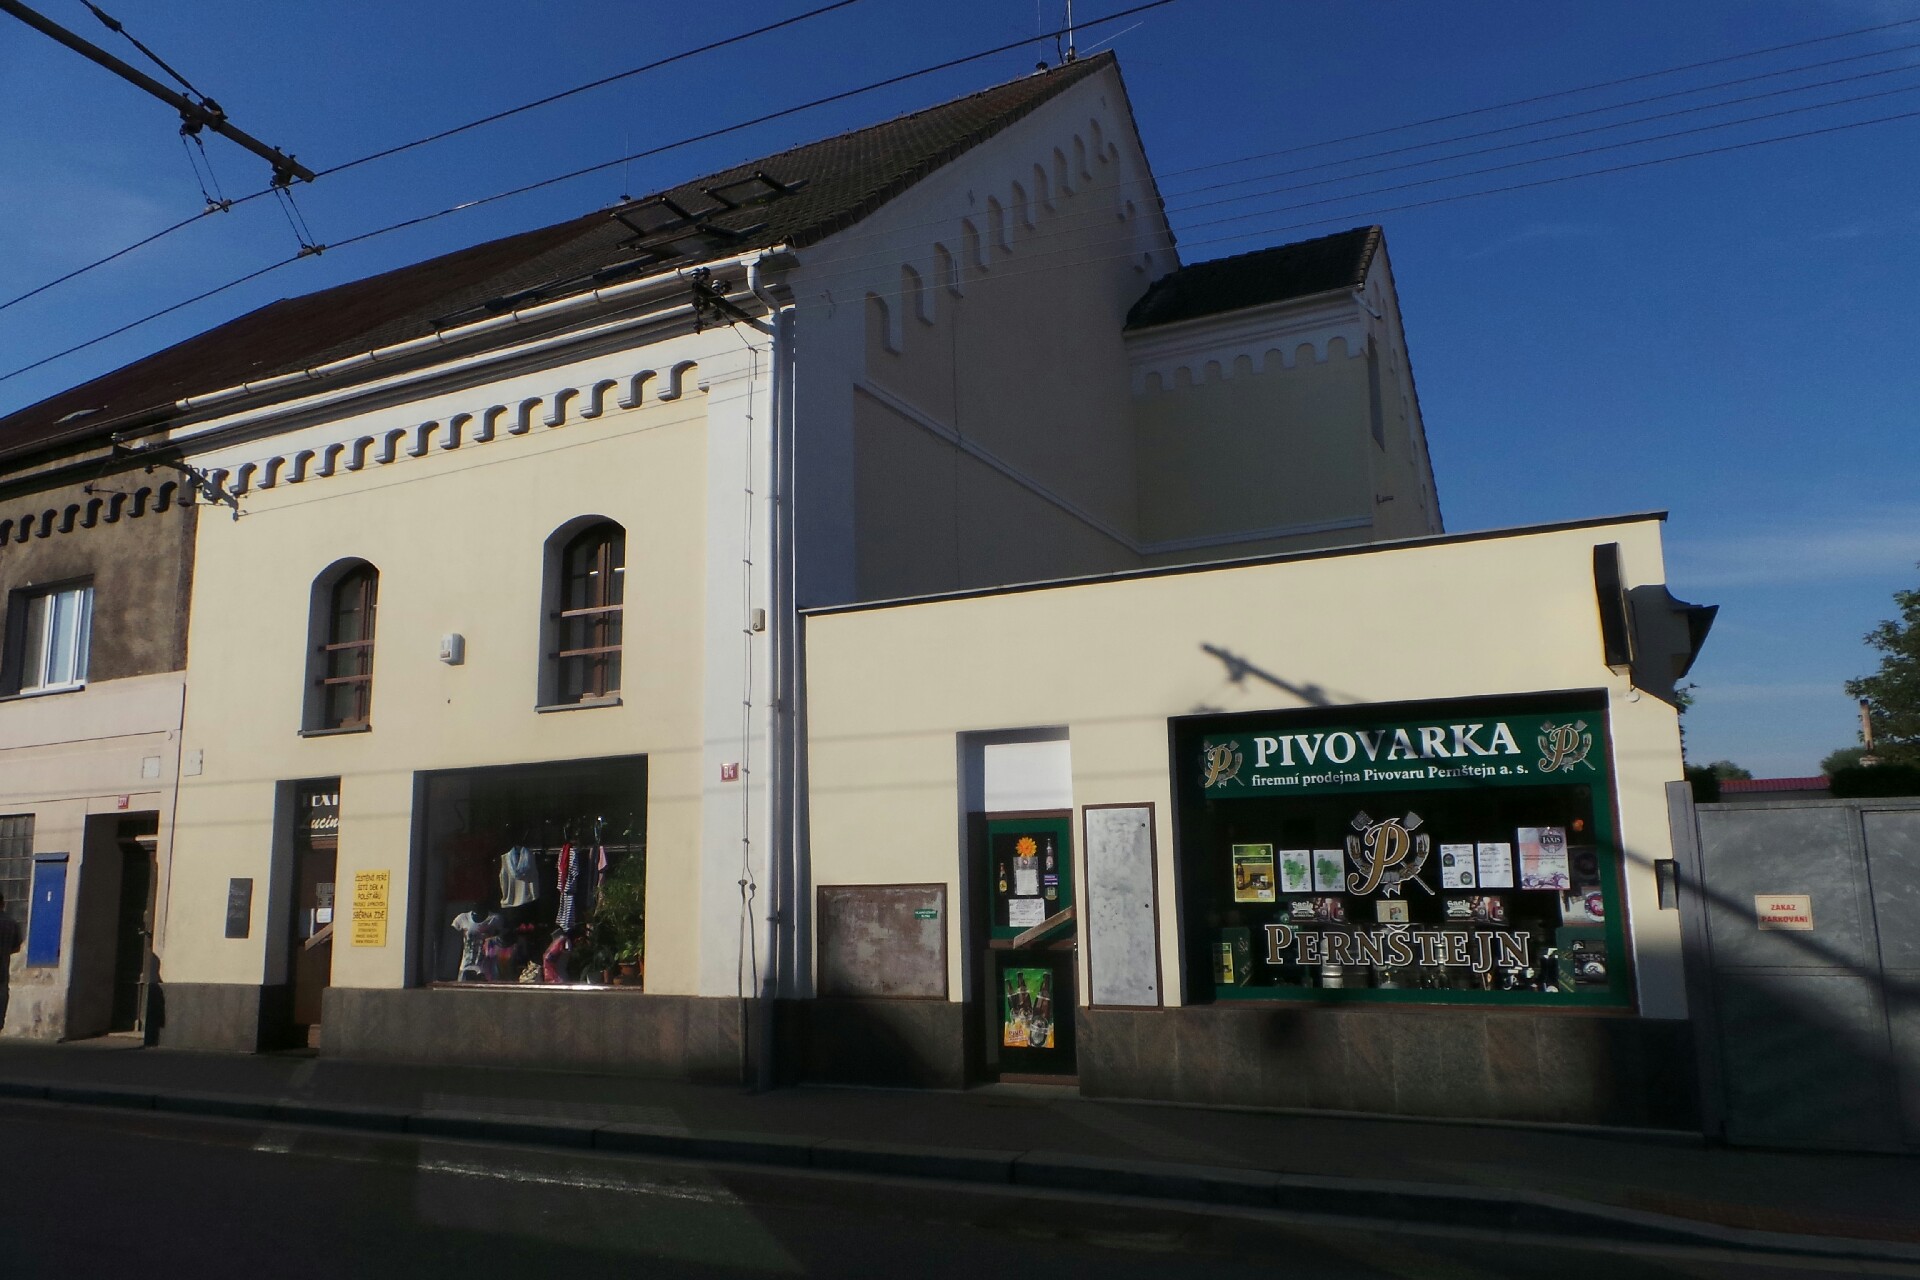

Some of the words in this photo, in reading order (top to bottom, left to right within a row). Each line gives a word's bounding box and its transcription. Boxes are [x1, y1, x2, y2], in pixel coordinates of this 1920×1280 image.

[1253, 721, 1522, 768] PIVOVARKA
[1251, 772, 1299, 787] firemní
[1302, 769, 1361, 787] prodejna
[1363, 767, 1424, 782] Pivovaru
[1428, 762, 1496, 780] Pernštejn
